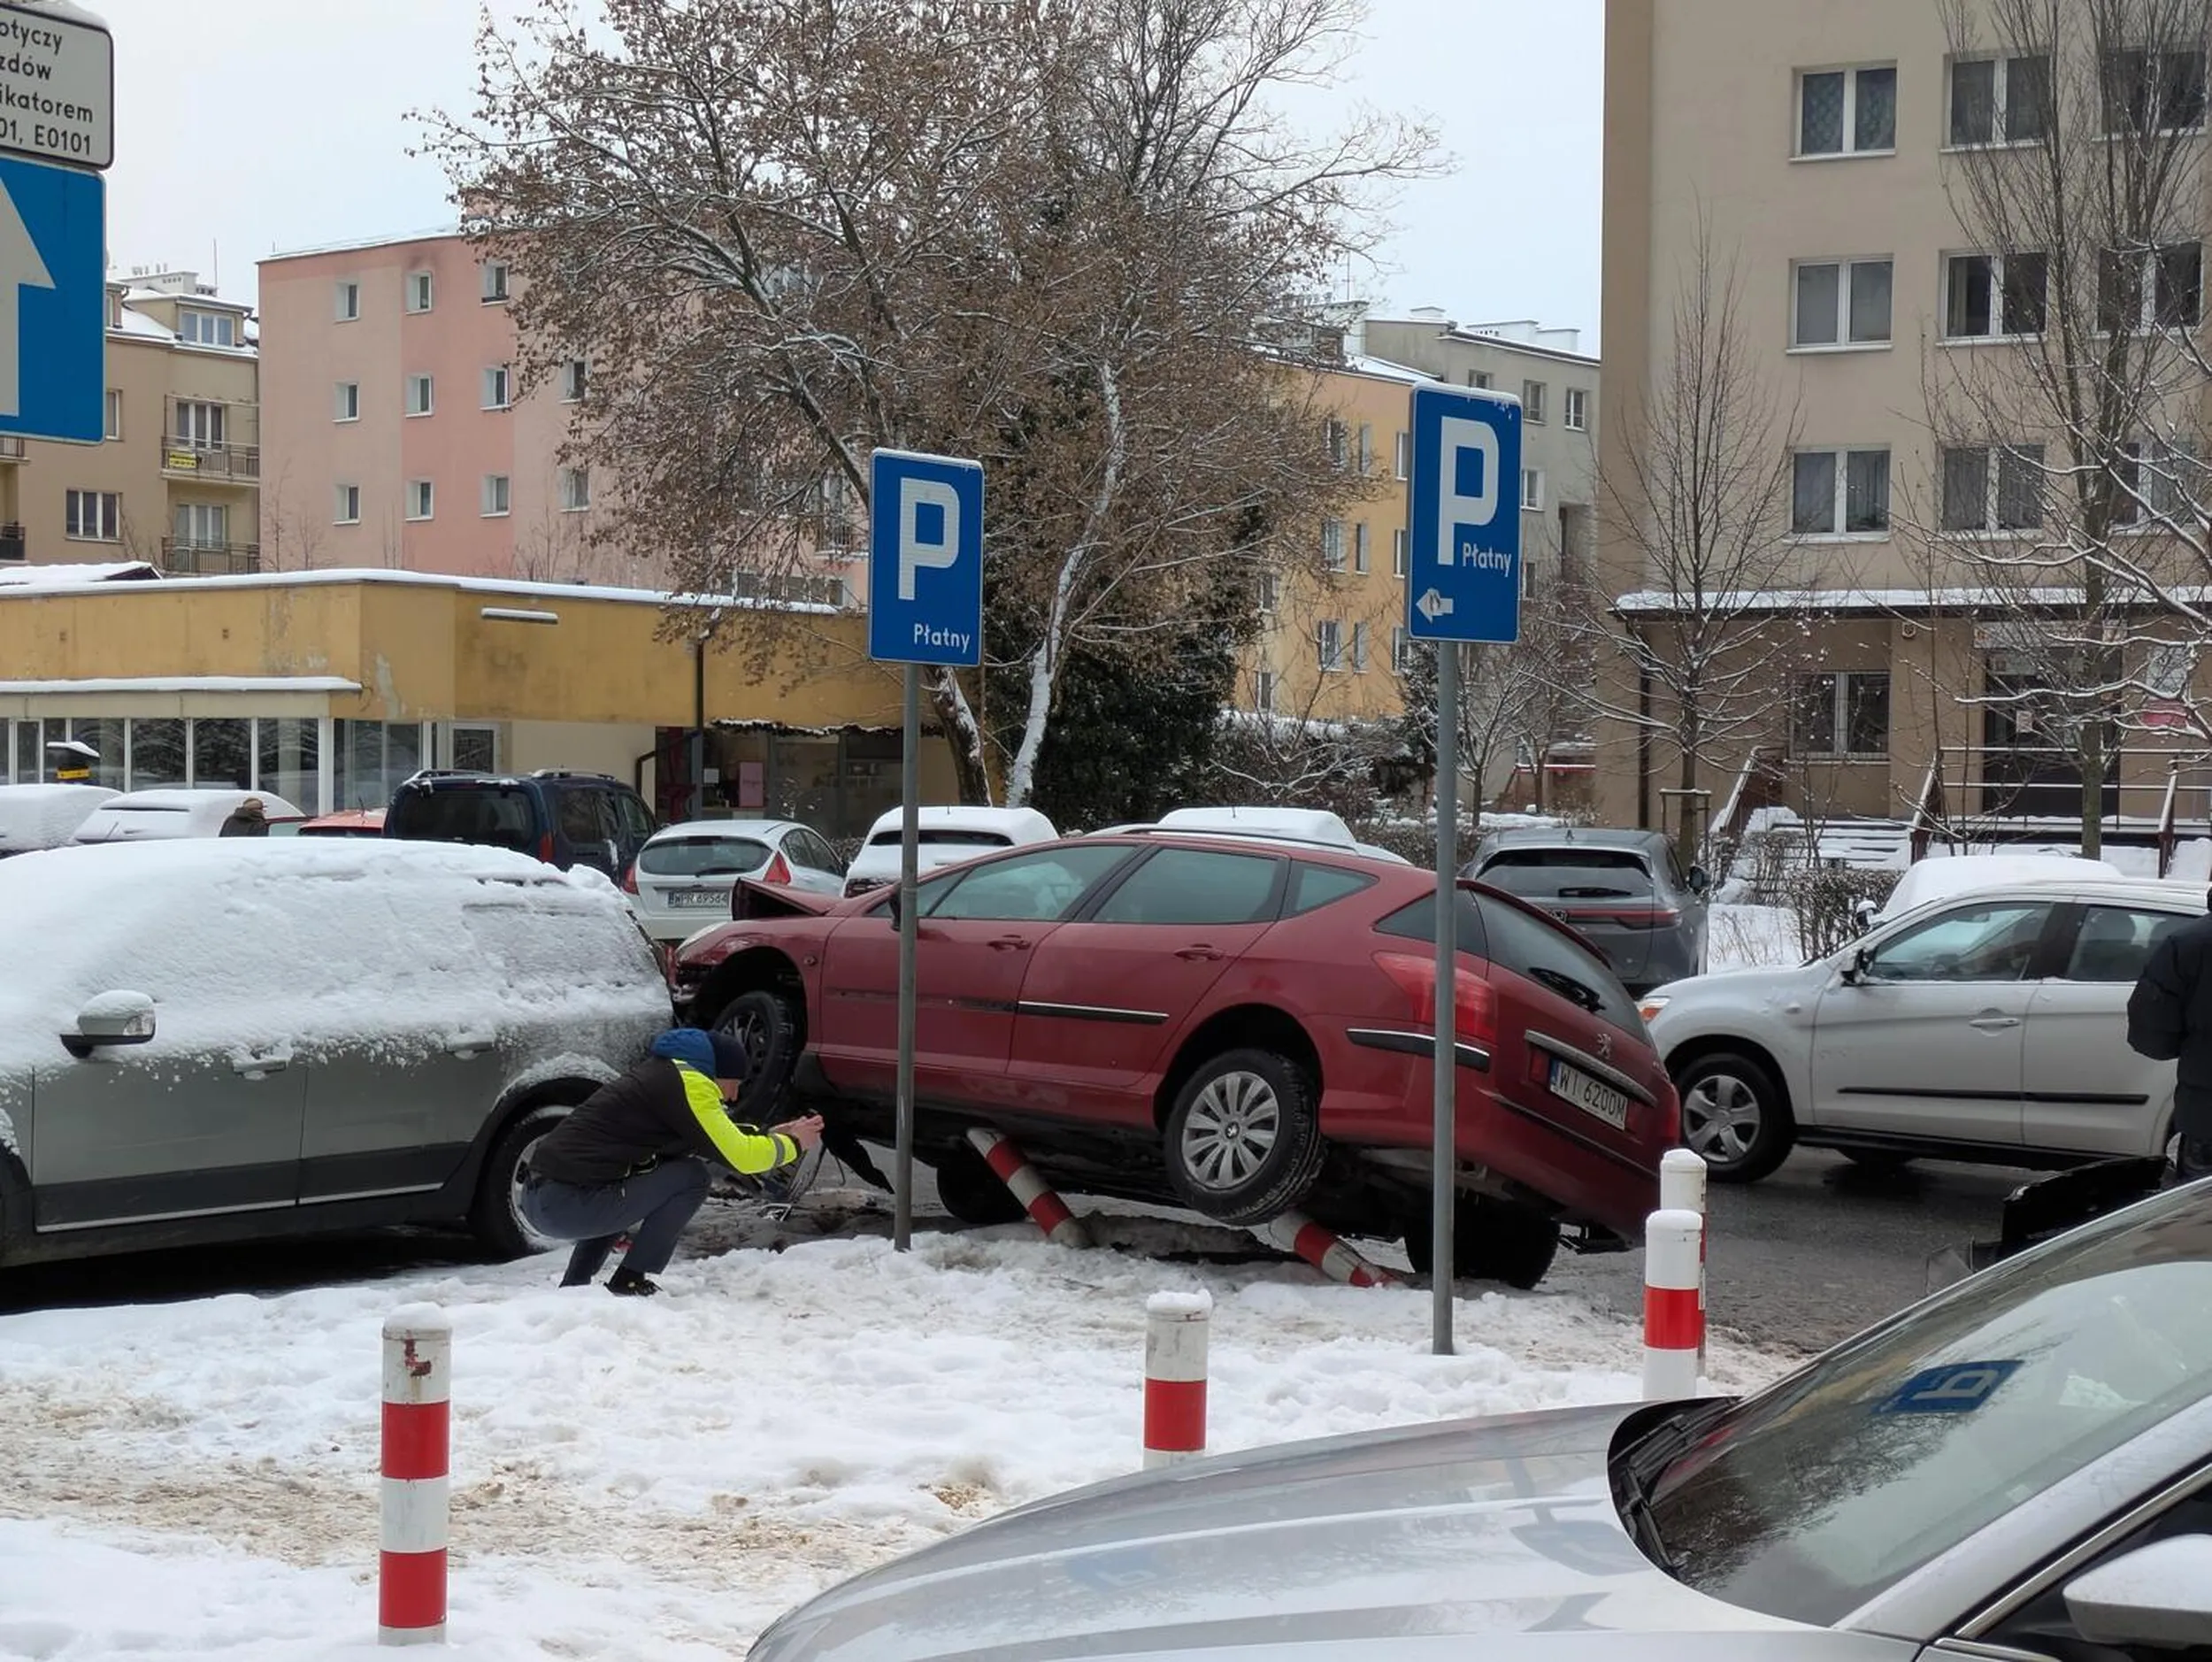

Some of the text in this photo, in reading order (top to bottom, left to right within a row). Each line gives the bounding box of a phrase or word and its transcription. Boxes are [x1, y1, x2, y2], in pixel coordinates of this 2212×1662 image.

[35, 124, 91, 156] E0101
[1437, 415, 1500, 566] P
[897, 476, 961, 601] P
[1462, 542, 1512, 578] Płatny
[913, 623, 971, 654] Płatny
